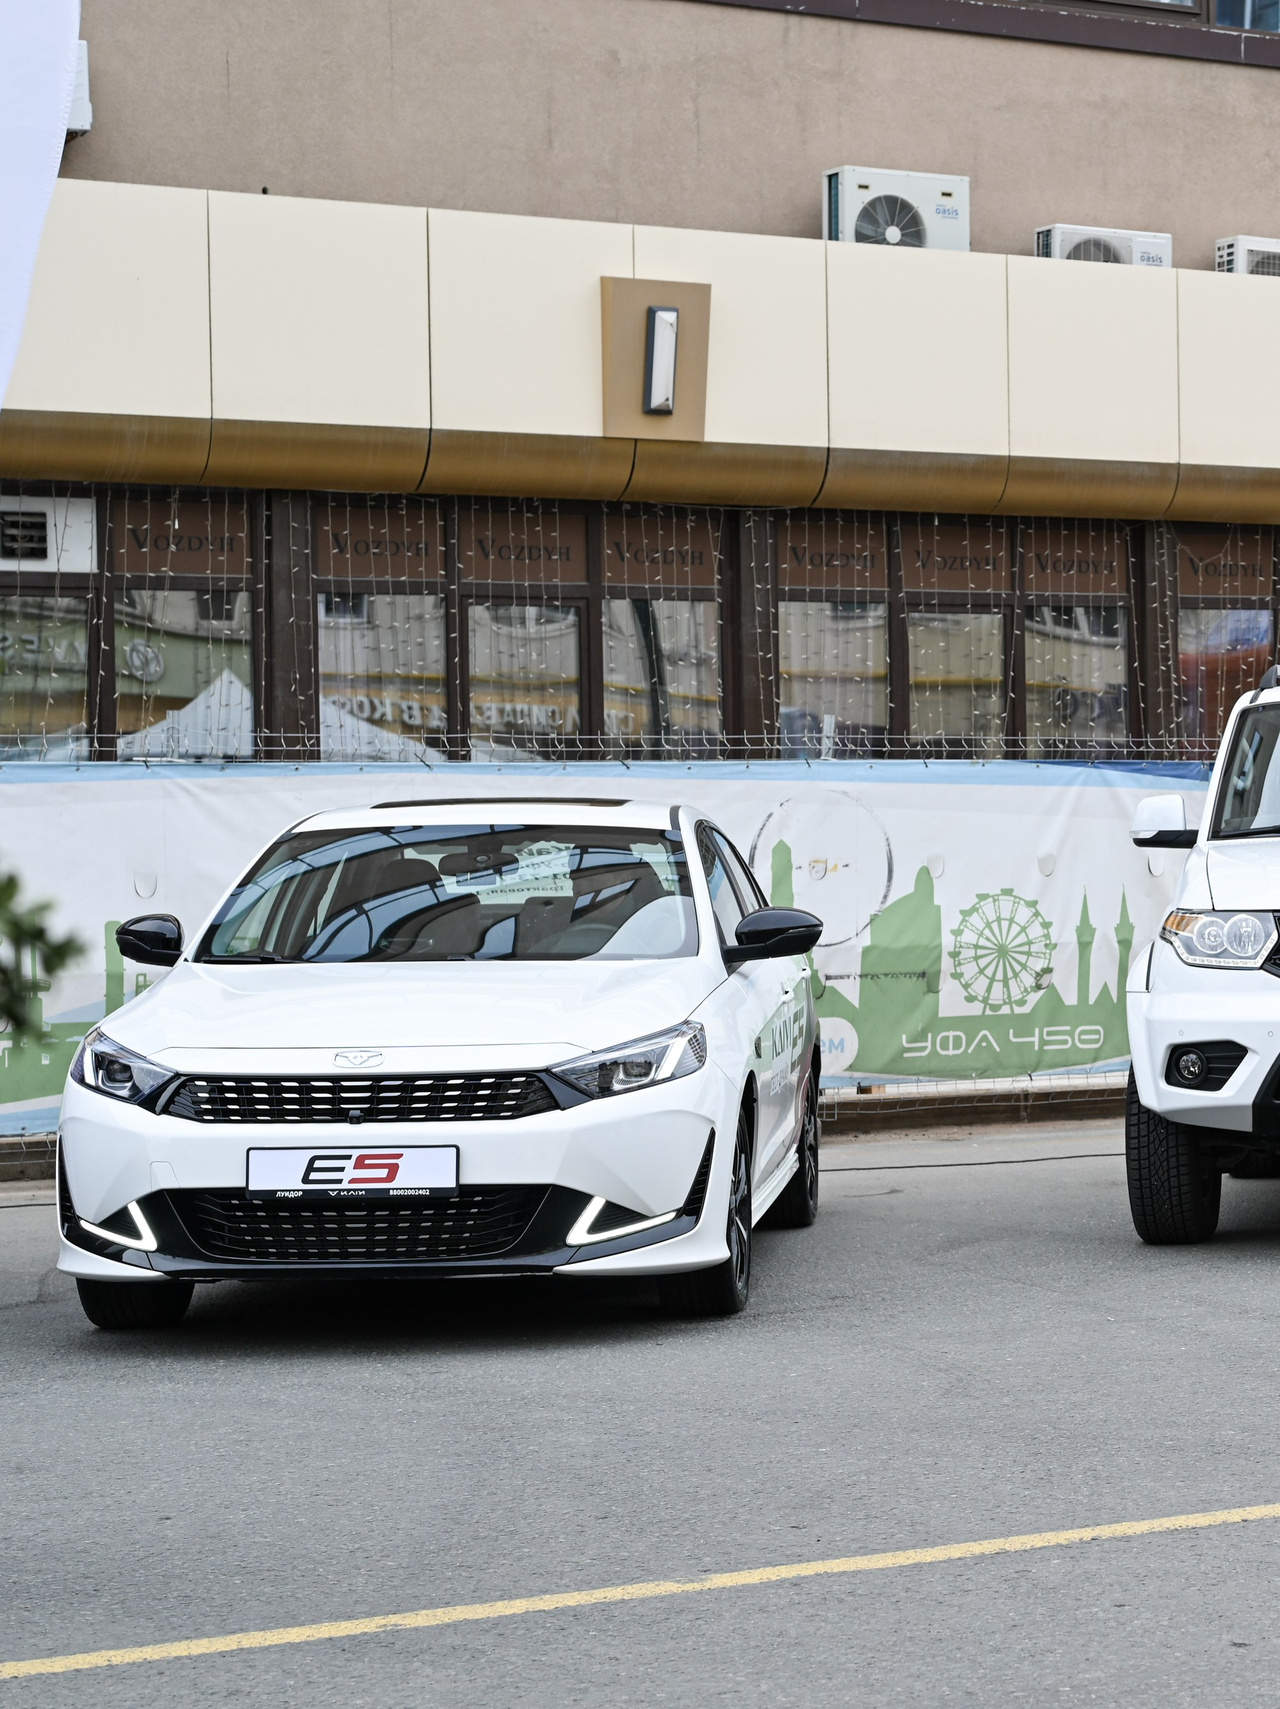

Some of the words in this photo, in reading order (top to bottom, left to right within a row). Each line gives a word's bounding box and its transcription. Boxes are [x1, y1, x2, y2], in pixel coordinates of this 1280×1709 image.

[902, 1029, 1000, 1057] УФА
[276, 1190, 303, 1198] ЛУИДОР
[389, 1188, 430, 1196] 88002002402
